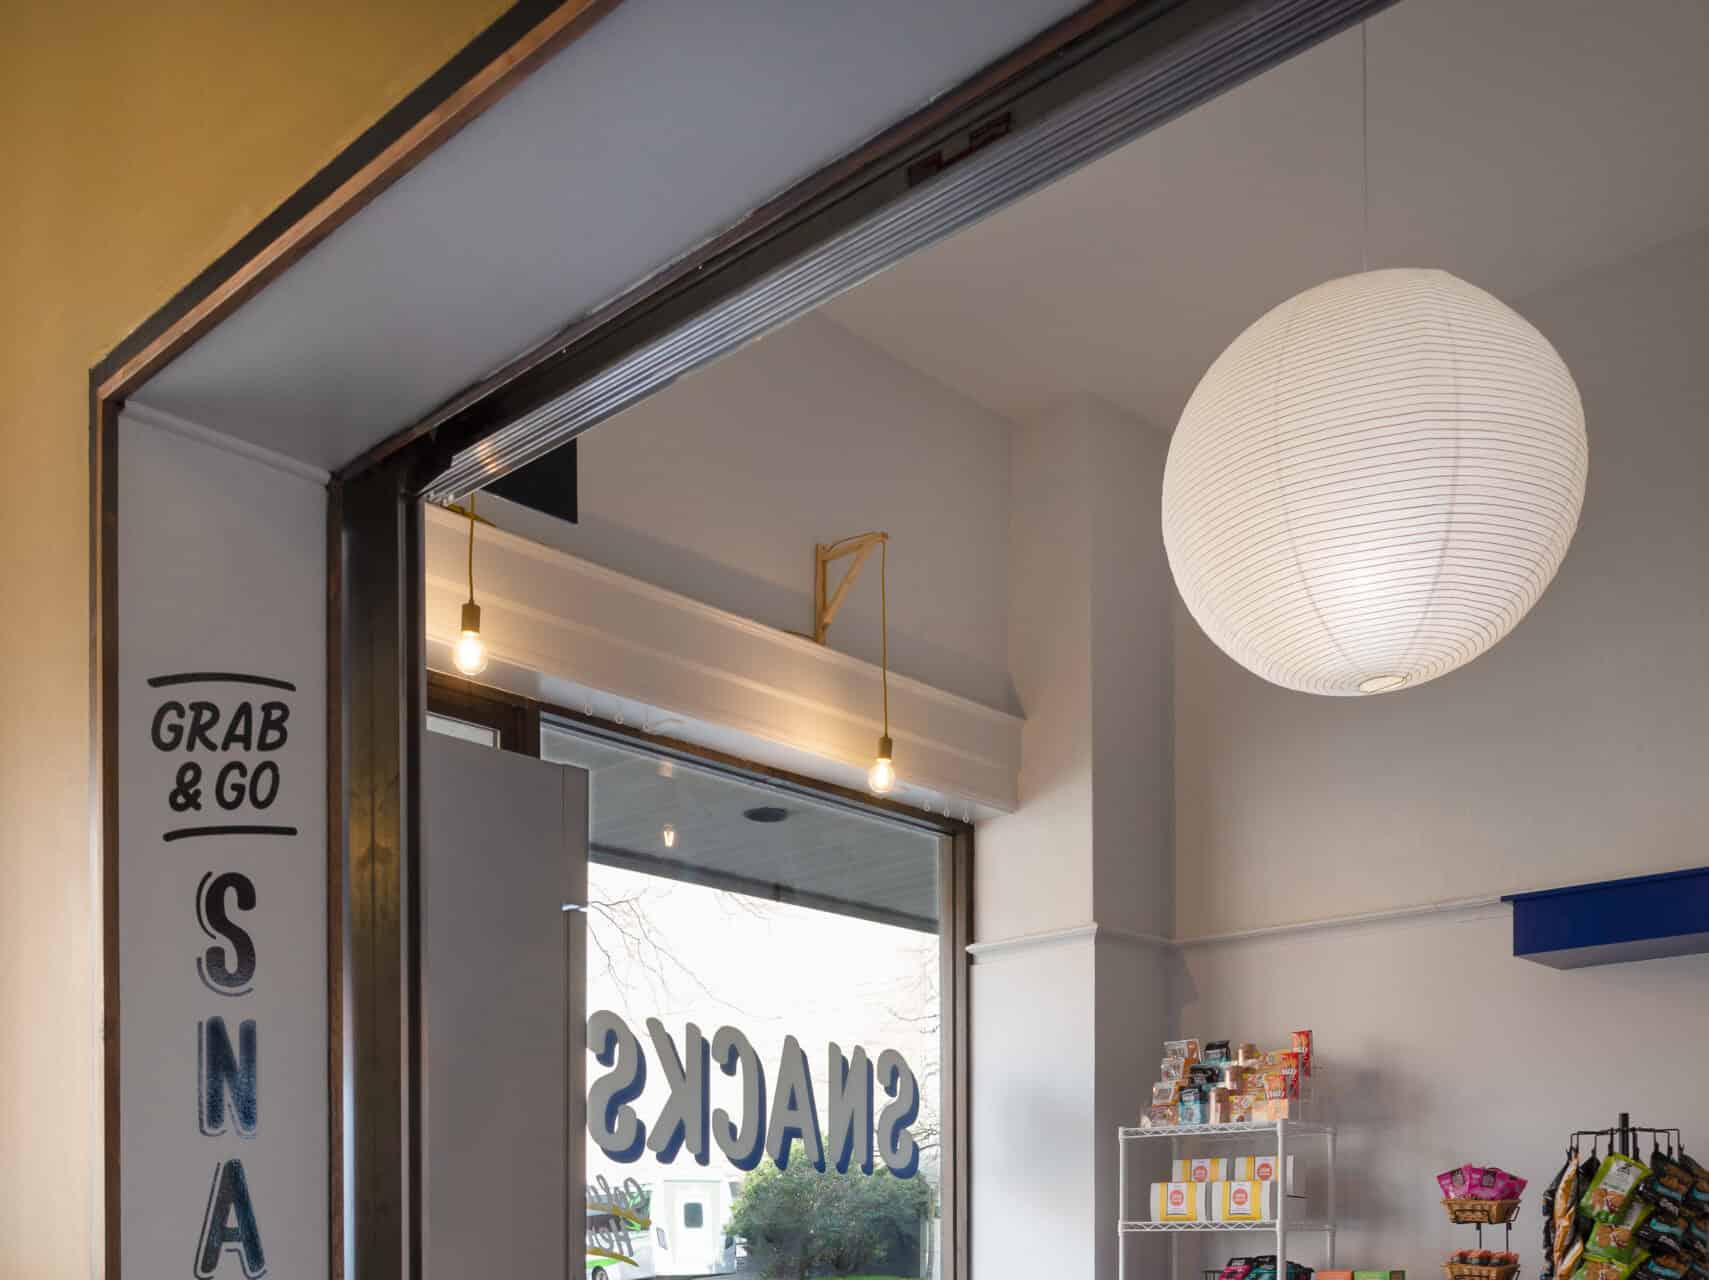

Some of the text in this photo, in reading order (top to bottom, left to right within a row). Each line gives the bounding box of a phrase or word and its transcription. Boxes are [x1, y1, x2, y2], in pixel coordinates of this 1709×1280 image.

[151, 700, 290, 752] GRAB
[168, 760, 281, 812] & GO
